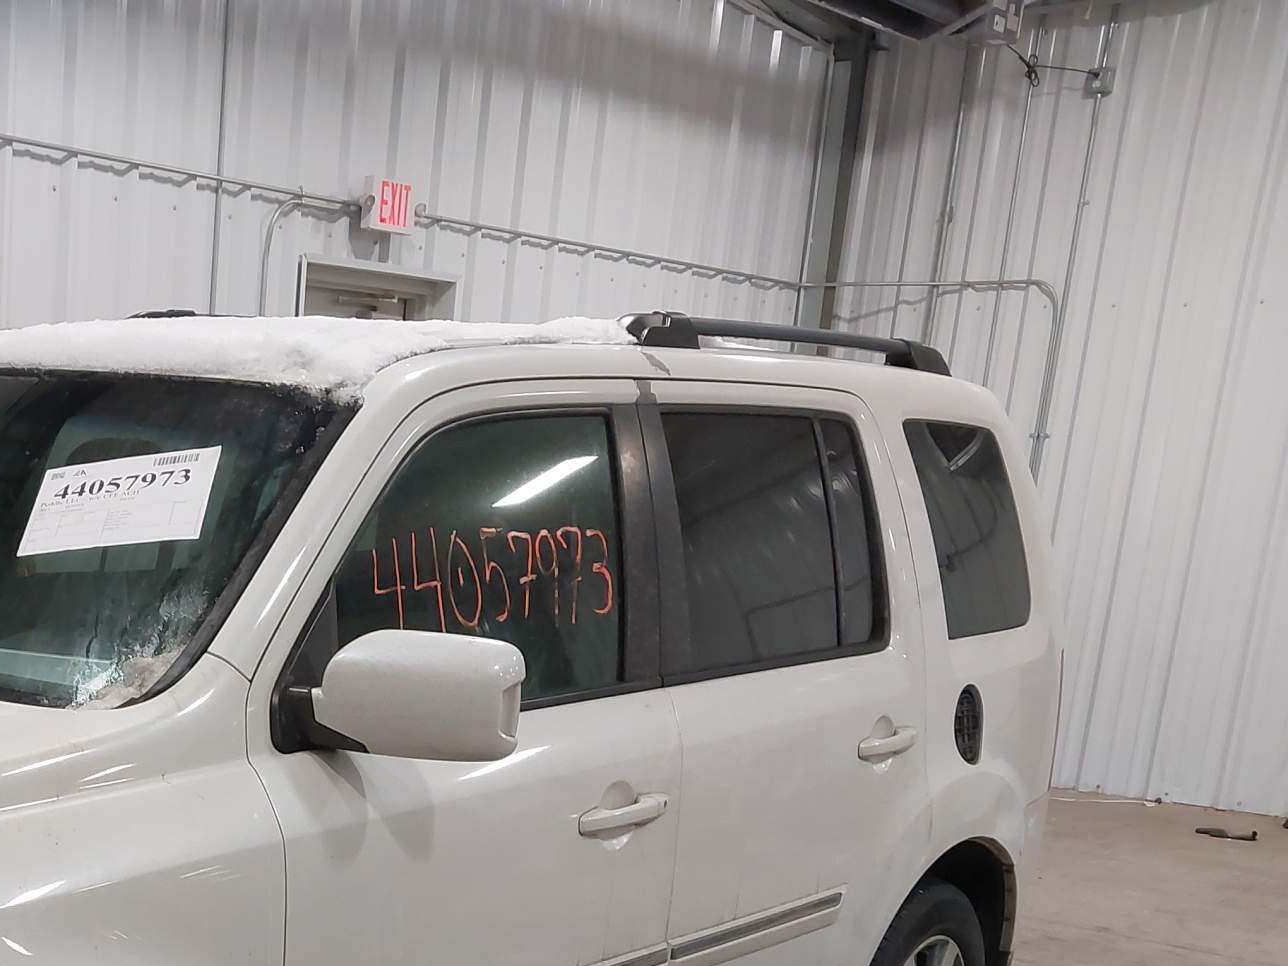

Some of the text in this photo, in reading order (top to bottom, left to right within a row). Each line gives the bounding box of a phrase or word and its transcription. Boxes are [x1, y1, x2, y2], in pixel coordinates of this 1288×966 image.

[379, 180, 411, 228] EXIT
[54, 468, 191, 500] 44057973
[371, 526, 613, 632] 44057973
